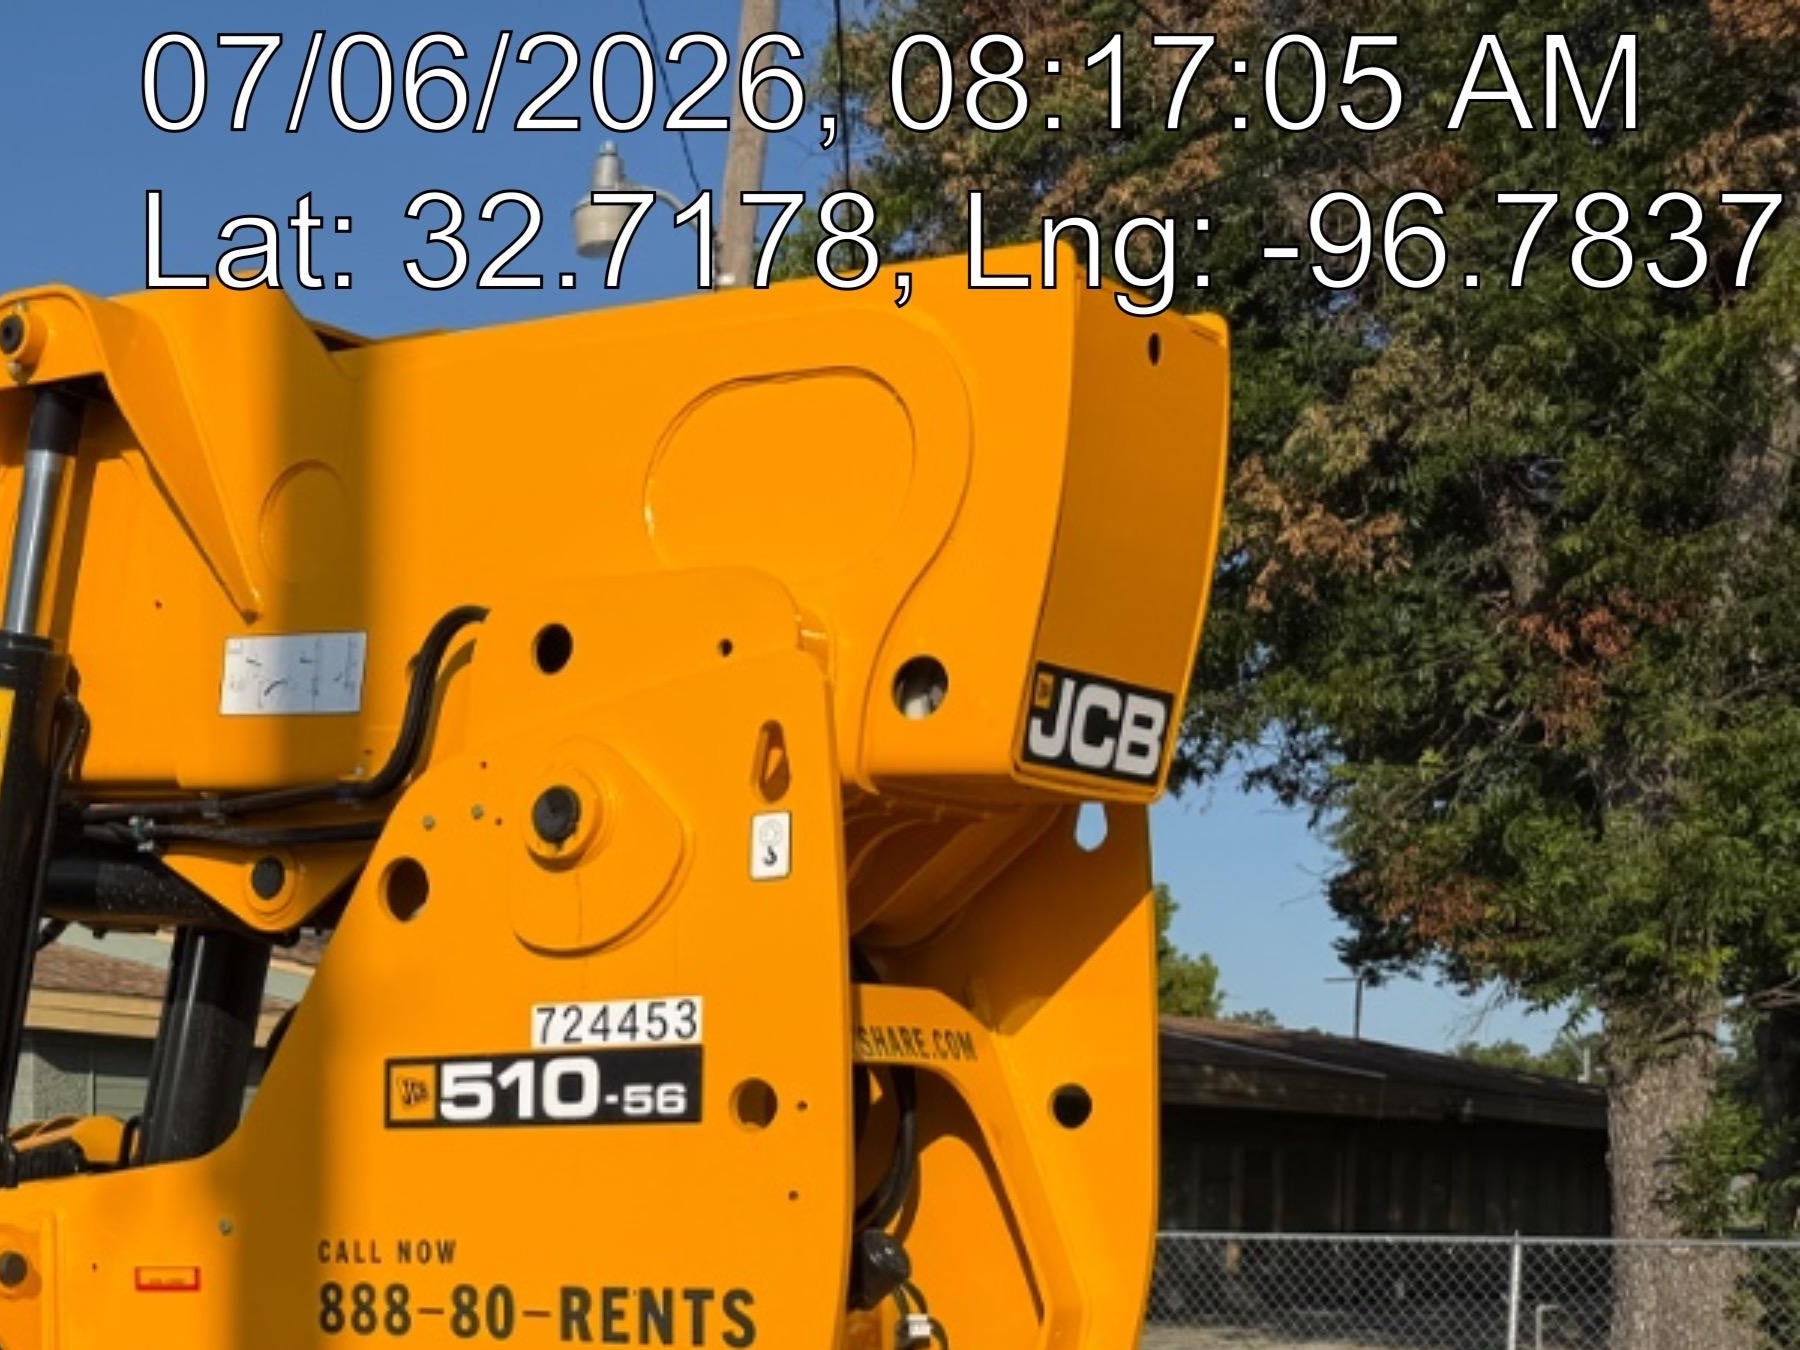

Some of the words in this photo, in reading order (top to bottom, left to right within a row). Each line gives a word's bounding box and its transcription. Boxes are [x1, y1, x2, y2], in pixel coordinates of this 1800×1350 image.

[1028, 677, 1167, 777] JCB
[535, 999, 699, 1045] 724453
[439, 1056, 688, 1122] 510-56
[317, 1239, 383, 1264] CALL
[397, 1239, 458, 1264] NOW
[318, 1280, 758, 1350] 888-80-RENTS
